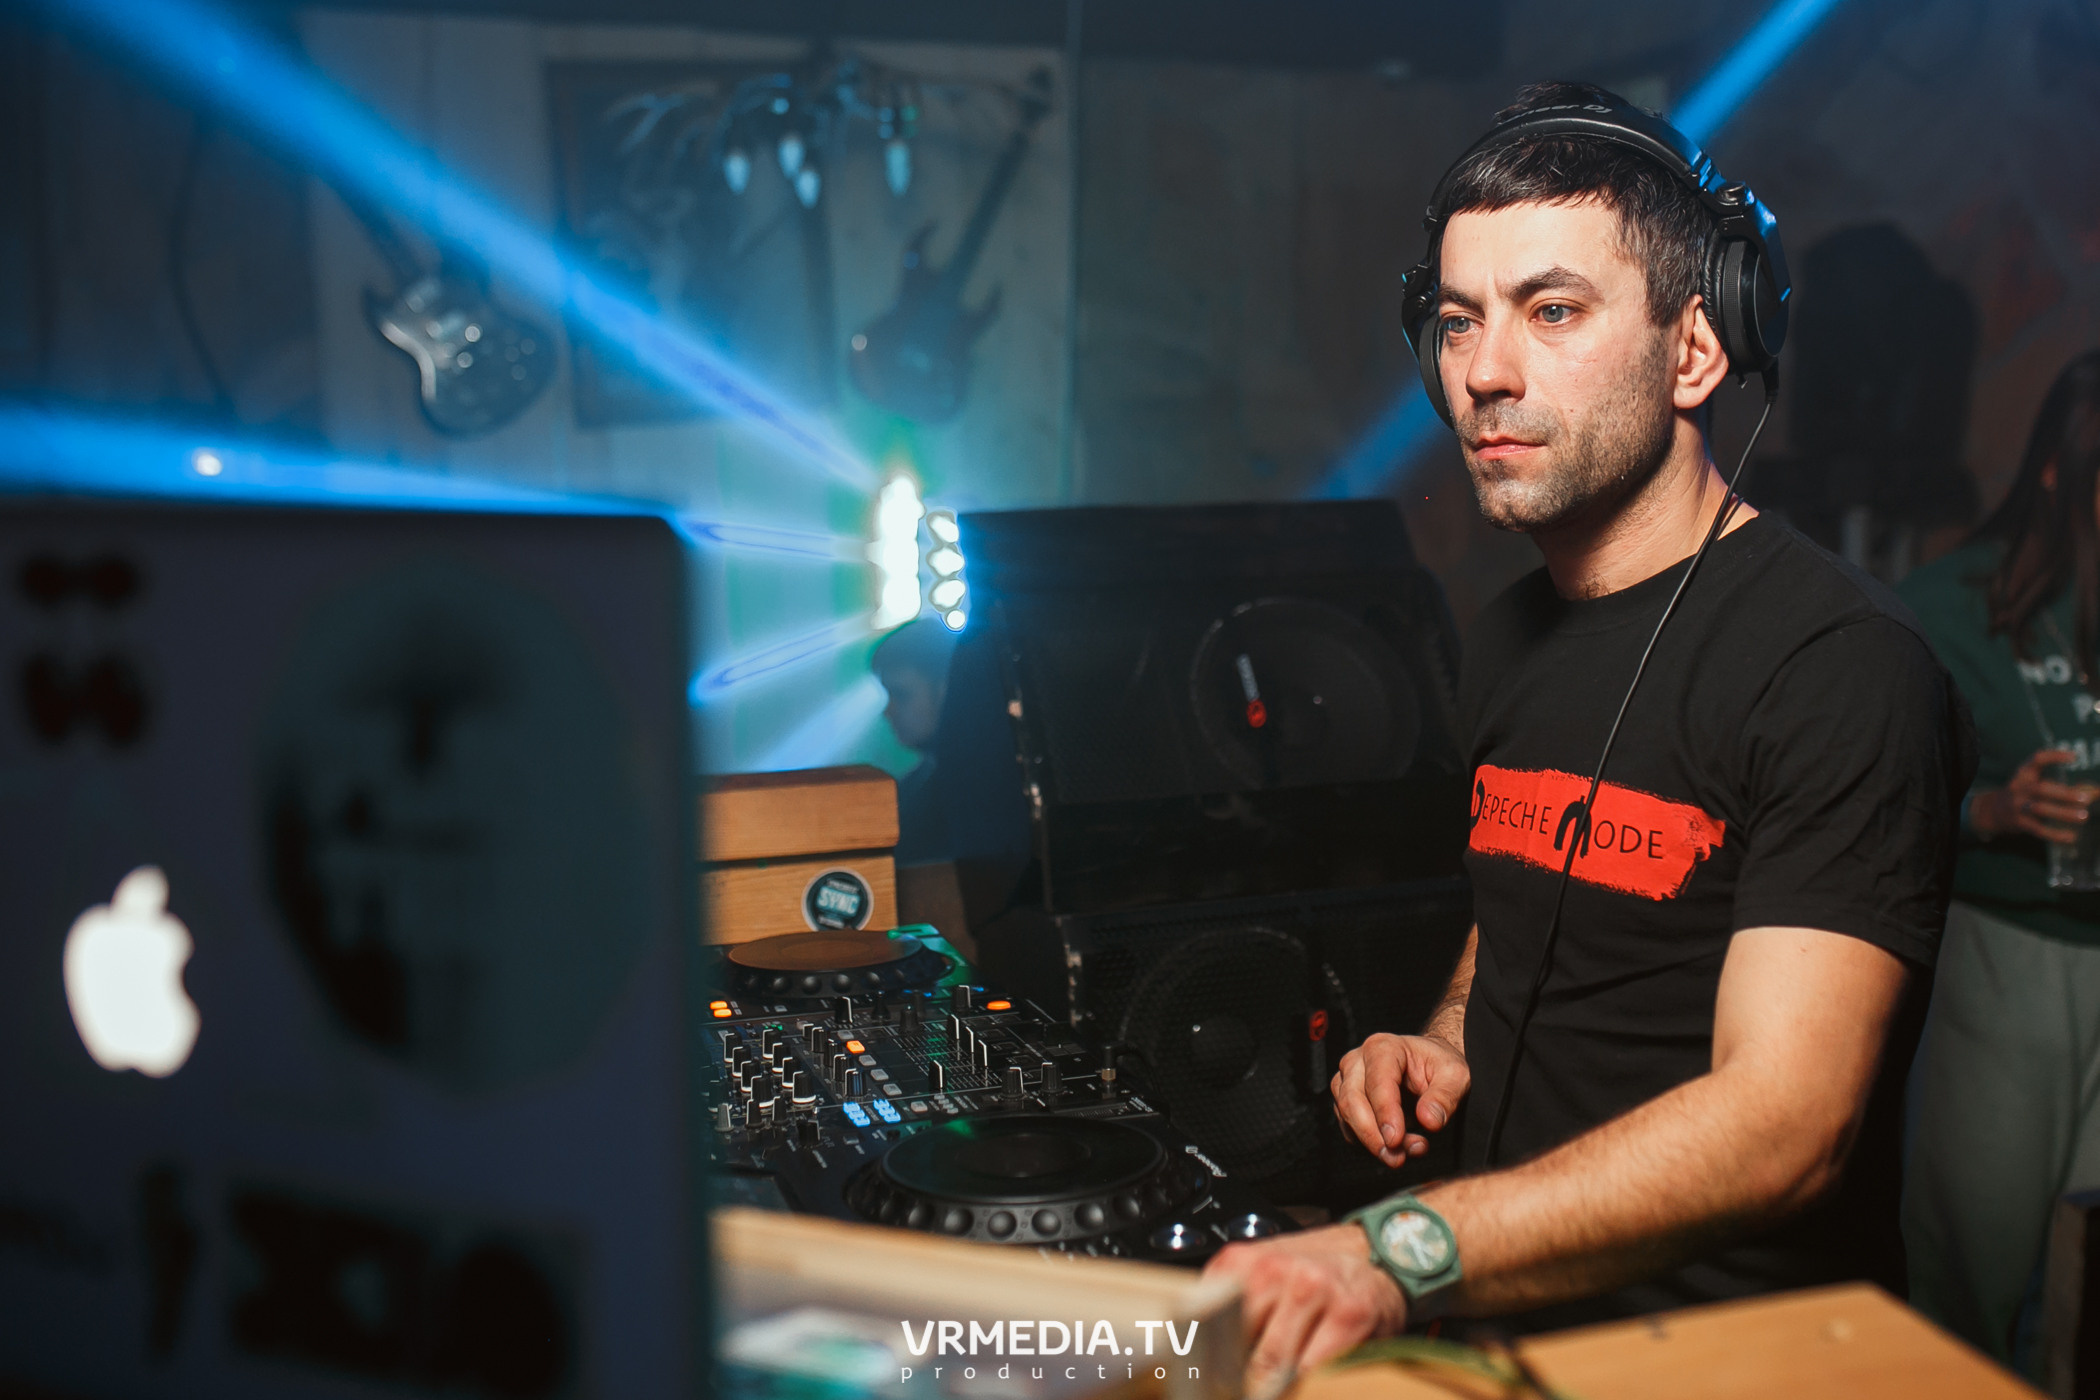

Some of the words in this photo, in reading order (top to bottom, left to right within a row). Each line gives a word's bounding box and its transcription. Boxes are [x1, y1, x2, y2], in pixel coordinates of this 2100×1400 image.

[1470, 777, 1552, 835] DEPECHE
[1553, 795, 1663, 859] MODE
[817, 886, 859, 915] SYNC
